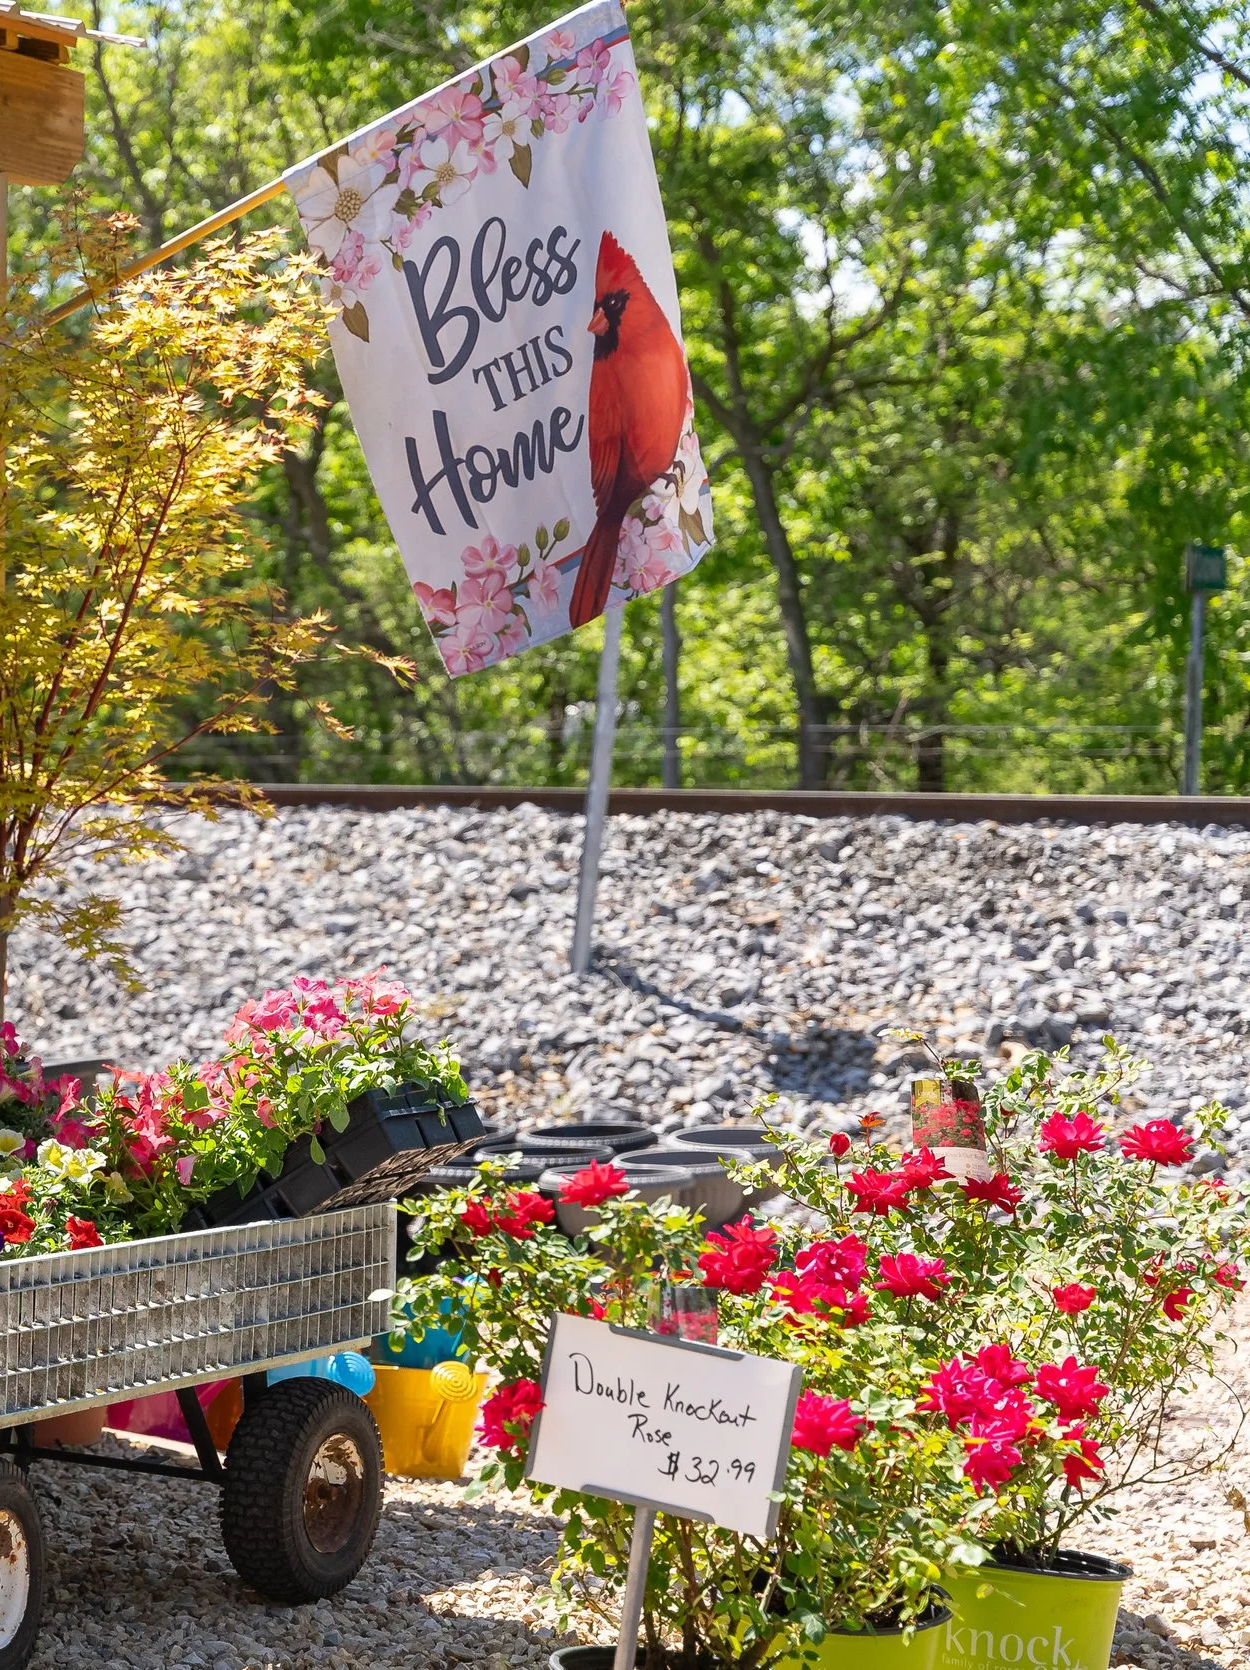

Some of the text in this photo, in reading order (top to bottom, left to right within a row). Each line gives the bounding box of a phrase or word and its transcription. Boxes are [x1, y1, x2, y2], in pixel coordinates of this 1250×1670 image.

[403, 216, 581, 385] Bless
[472, 325, 573, 412] THIS
[405, 406, 585, 536] Home
[569, 1353, 650, 1408] Double
[628, 1413, 672, 1447] Rose
[942, 1653, 973, 1669] family
[945, 1619, 1075, 1666] knock
